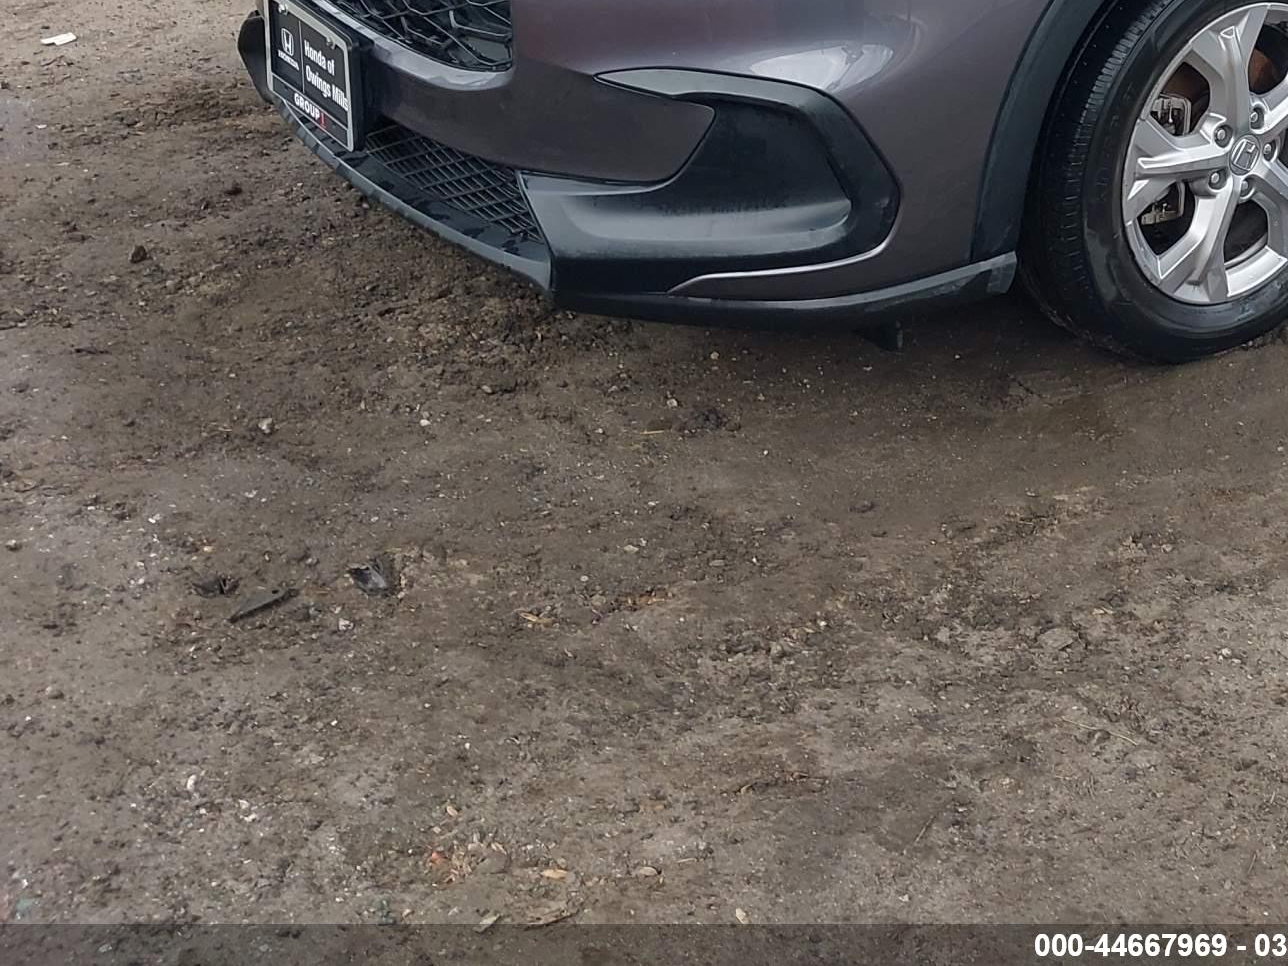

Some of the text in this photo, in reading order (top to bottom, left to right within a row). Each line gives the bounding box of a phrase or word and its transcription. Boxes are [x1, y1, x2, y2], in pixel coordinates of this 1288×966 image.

[303, 39, 335, 76] Honda of
[305, 64, 348, 111] Owings Mills
